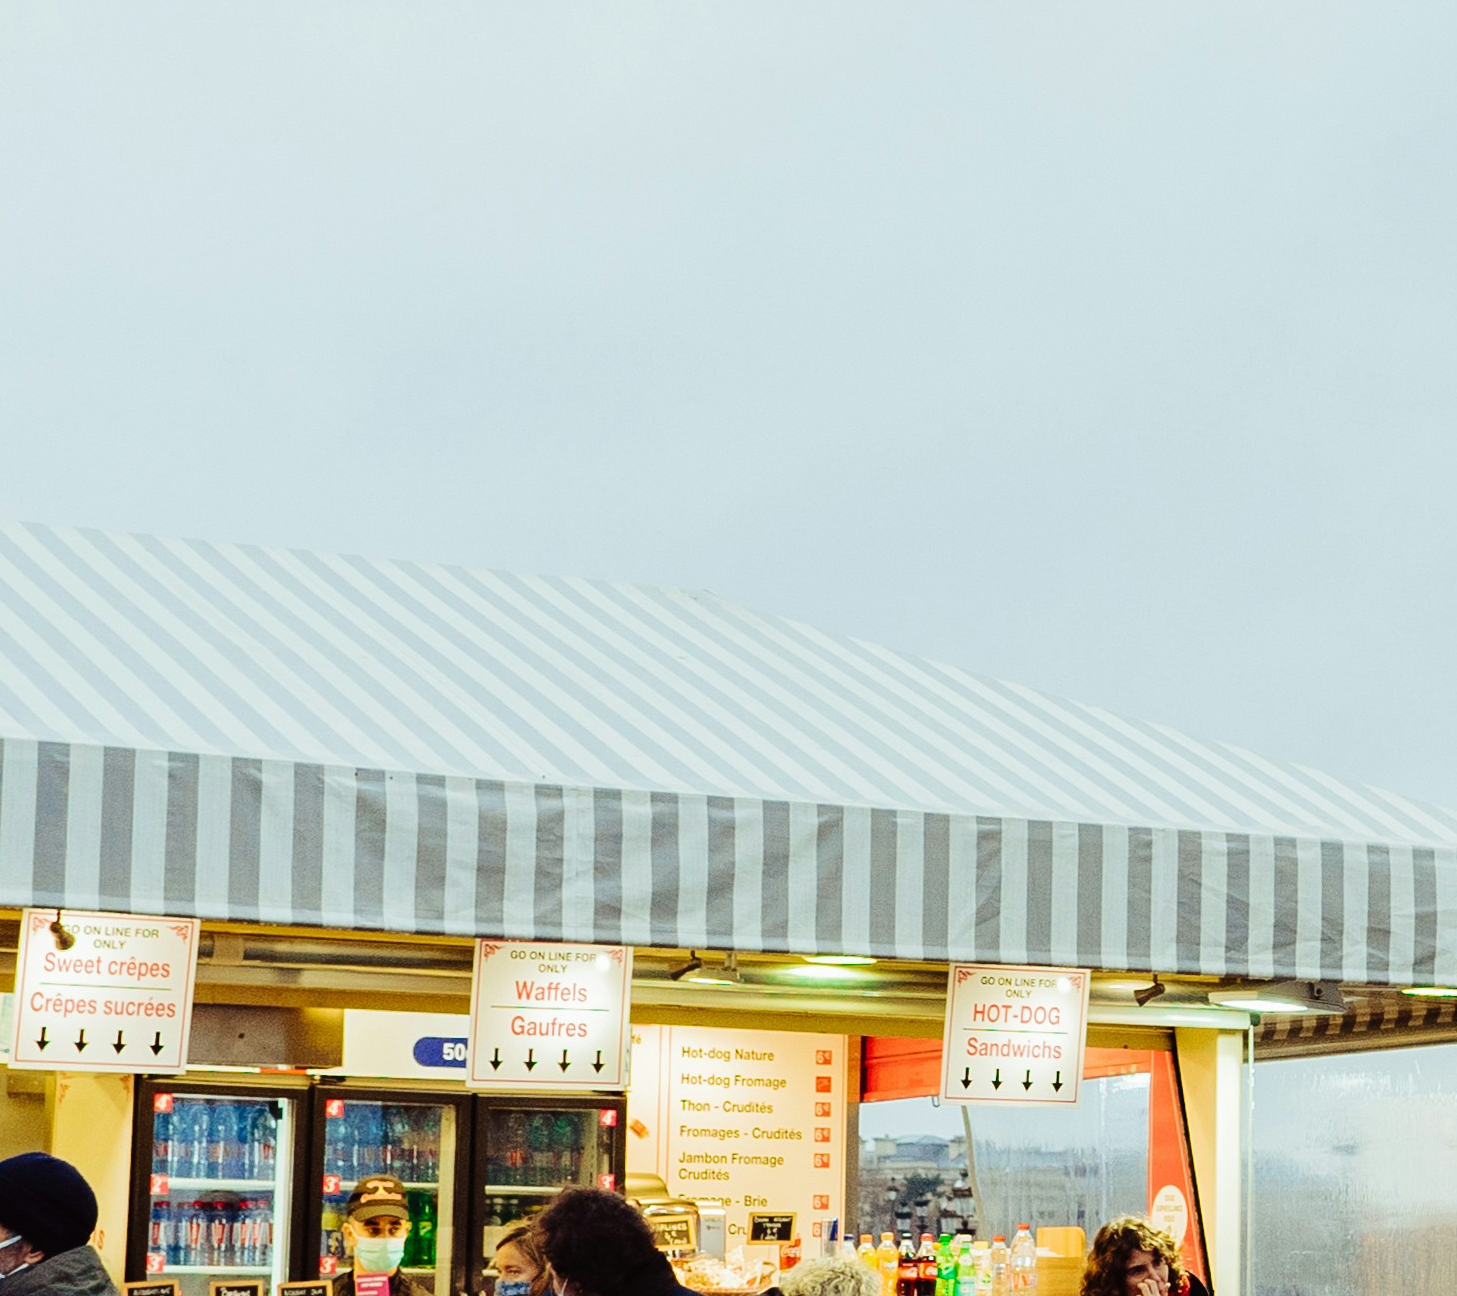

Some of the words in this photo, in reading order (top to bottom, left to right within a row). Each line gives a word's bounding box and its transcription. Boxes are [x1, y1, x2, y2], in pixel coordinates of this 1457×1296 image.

[84, 925, 101, 936] ON
[105, 926, 131, 937] LINE
[135, 928, 159, 939] FOR
[94, 939, 126, 950] ONLY
[510, 950, 527, 960] GO
[530, 951, 545, 961] ON
[548, 952, 573, 962] LINE
[43, 952, 102, 974] Sweet
[108, 957, 171, 981] crêpes
[538, 964, 568, 974] ONLY
[980, 976, 996, 986] GO
[998, 977, 1012, 986] ON
[1014, 978, 1036, 988] LINE
[515, 980, 588, 1002] Waffels
[1005, 989, 1032, 999] ONLY
[30, 992, 97, 1018] Crêpes
[103, 997, 176, 1019] sucrées
[973, 1003, 1061, 1025] HOT-DOG
[510, 1015, 588, 1038] Gaufres
[442, 1042, 467, 1061] 50
[682, 1046, 731, 1062] Hot-dog
[734, 1048, 775, 1062] Nature
[966, 1036, 1062, 1059] Sandwichs
[681, 1073, 730, 1088] Hot-dog
[734, 1075, 787, 1090] Fromage
[681, 1099, 711, 1112] Thon
[722, 1100, 774, 1114] Crudités
[680, 1125, 740, 1140] Fromages
[752, 1127, 803, 1140] Crudités
[679, 1152, 728, 1165] Jambon
[731, 1153, 785, 1168] Fromage
[679, 1168, 730, 1181] Crudités
[744, 1195, 768, 1207] Brie
